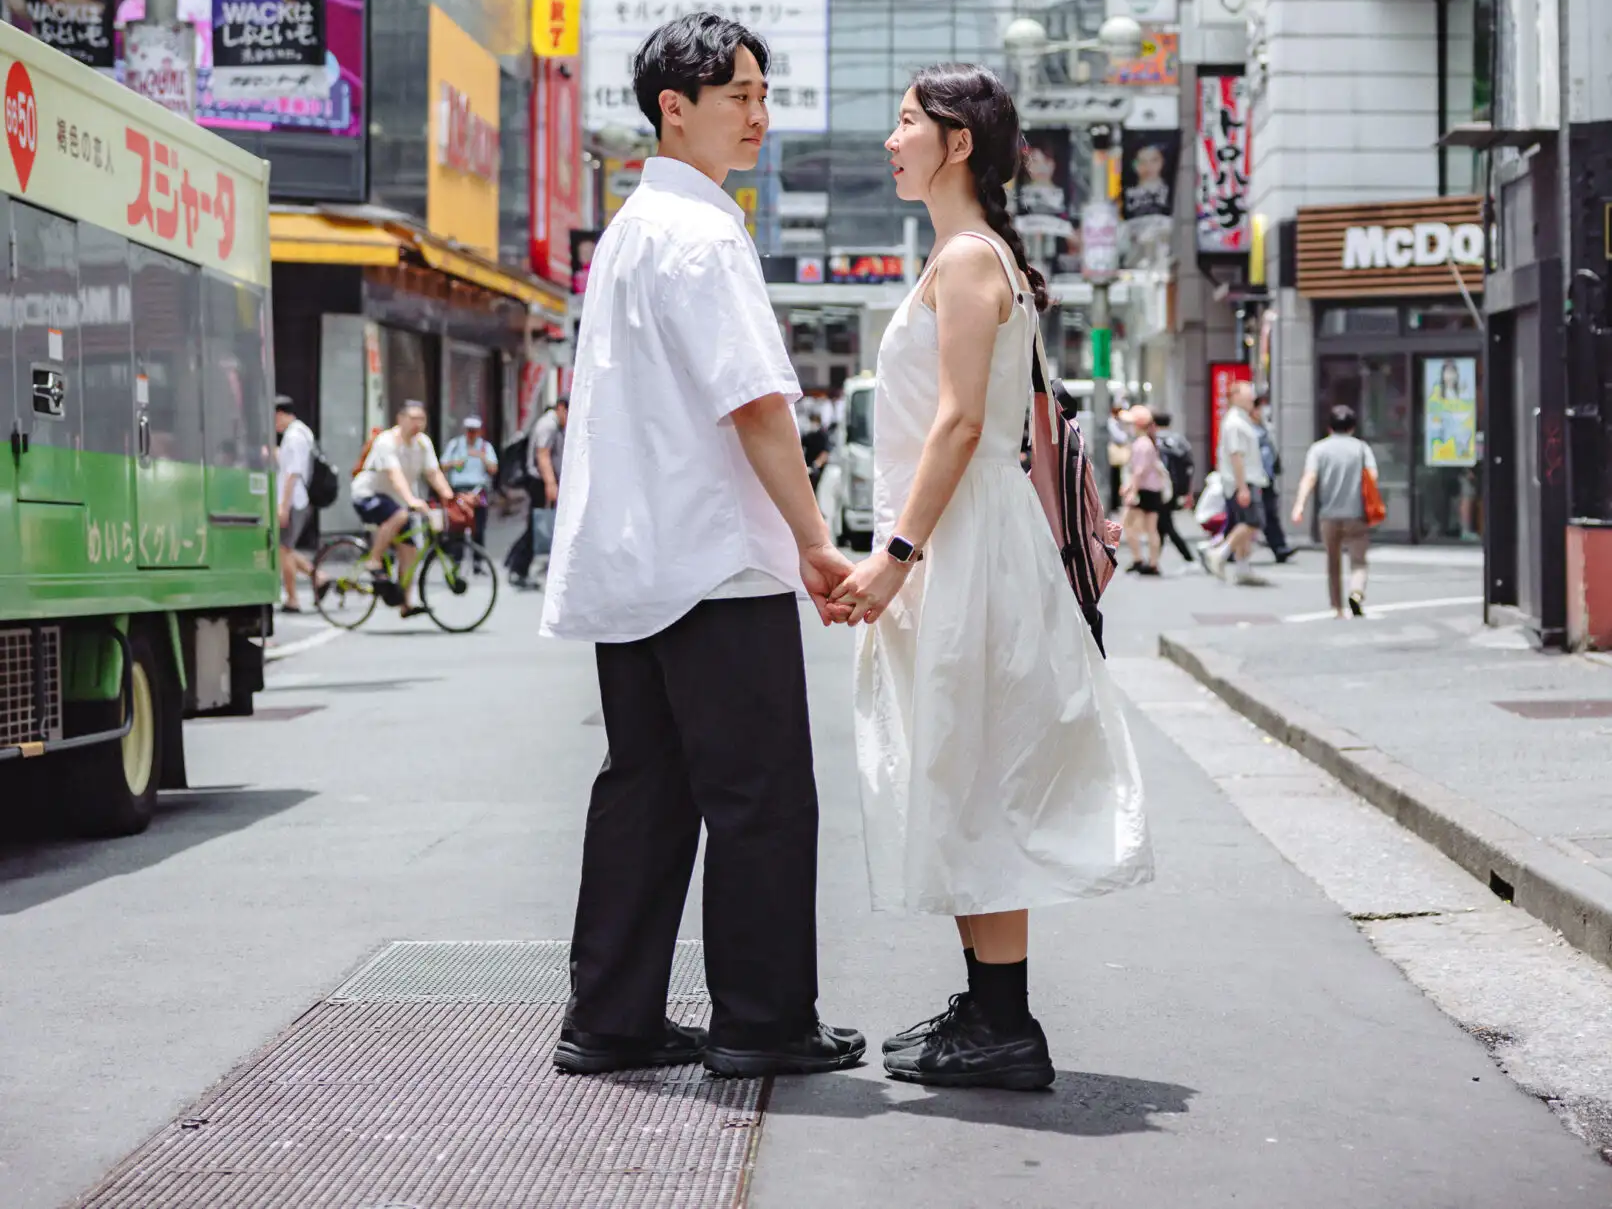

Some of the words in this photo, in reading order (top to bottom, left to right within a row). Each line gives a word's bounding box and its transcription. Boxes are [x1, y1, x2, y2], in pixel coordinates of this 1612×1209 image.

[125, 125, 236, 261] スジャータ
